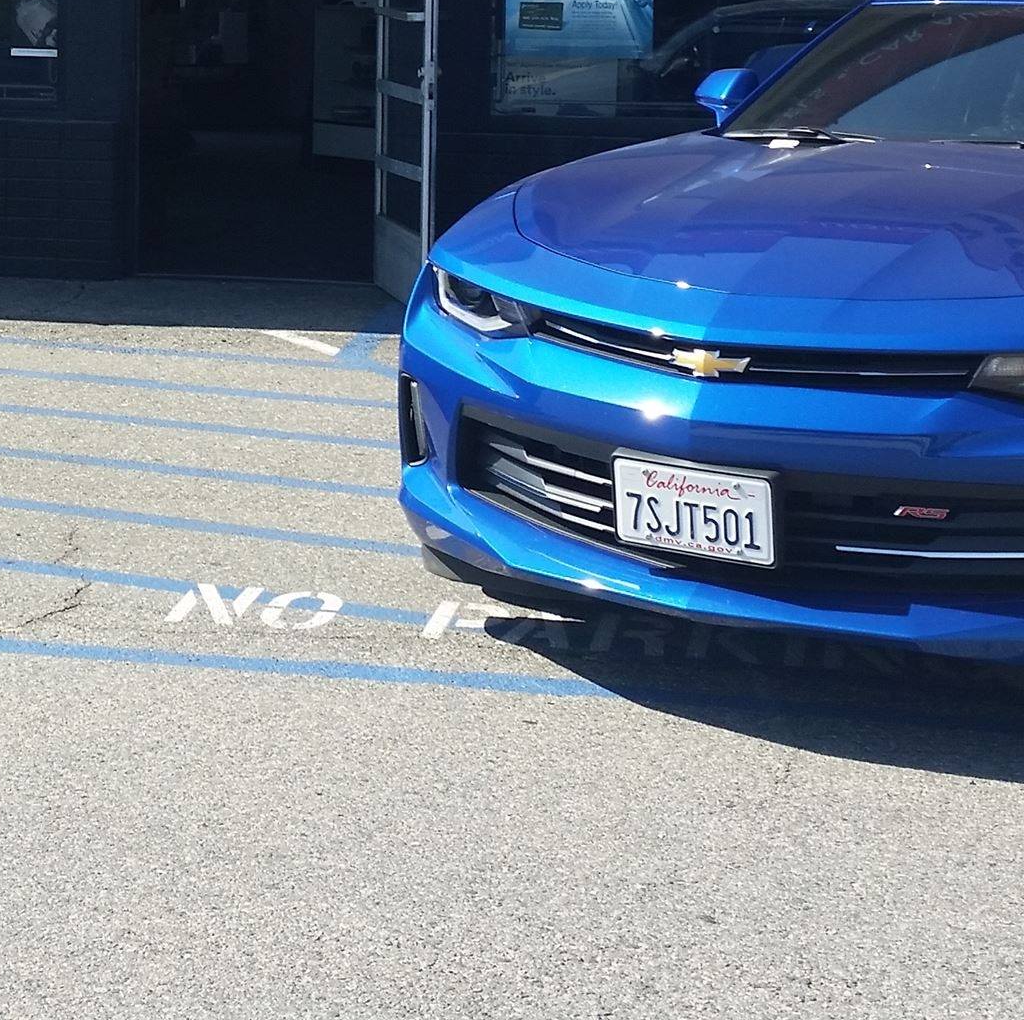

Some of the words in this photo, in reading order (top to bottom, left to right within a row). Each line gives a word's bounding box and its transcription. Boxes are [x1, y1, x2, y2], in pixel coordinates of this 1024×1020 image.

[571, 0, 593, 10] Apply
[645, 470, 740, 500] California
[626, 491, 761, 551] 7SJT501
[656, 534, 734, 556] dmv.ca.gov
[164, 582, 344, 631] NO
[422, 599, 906, 670] PARKIN
